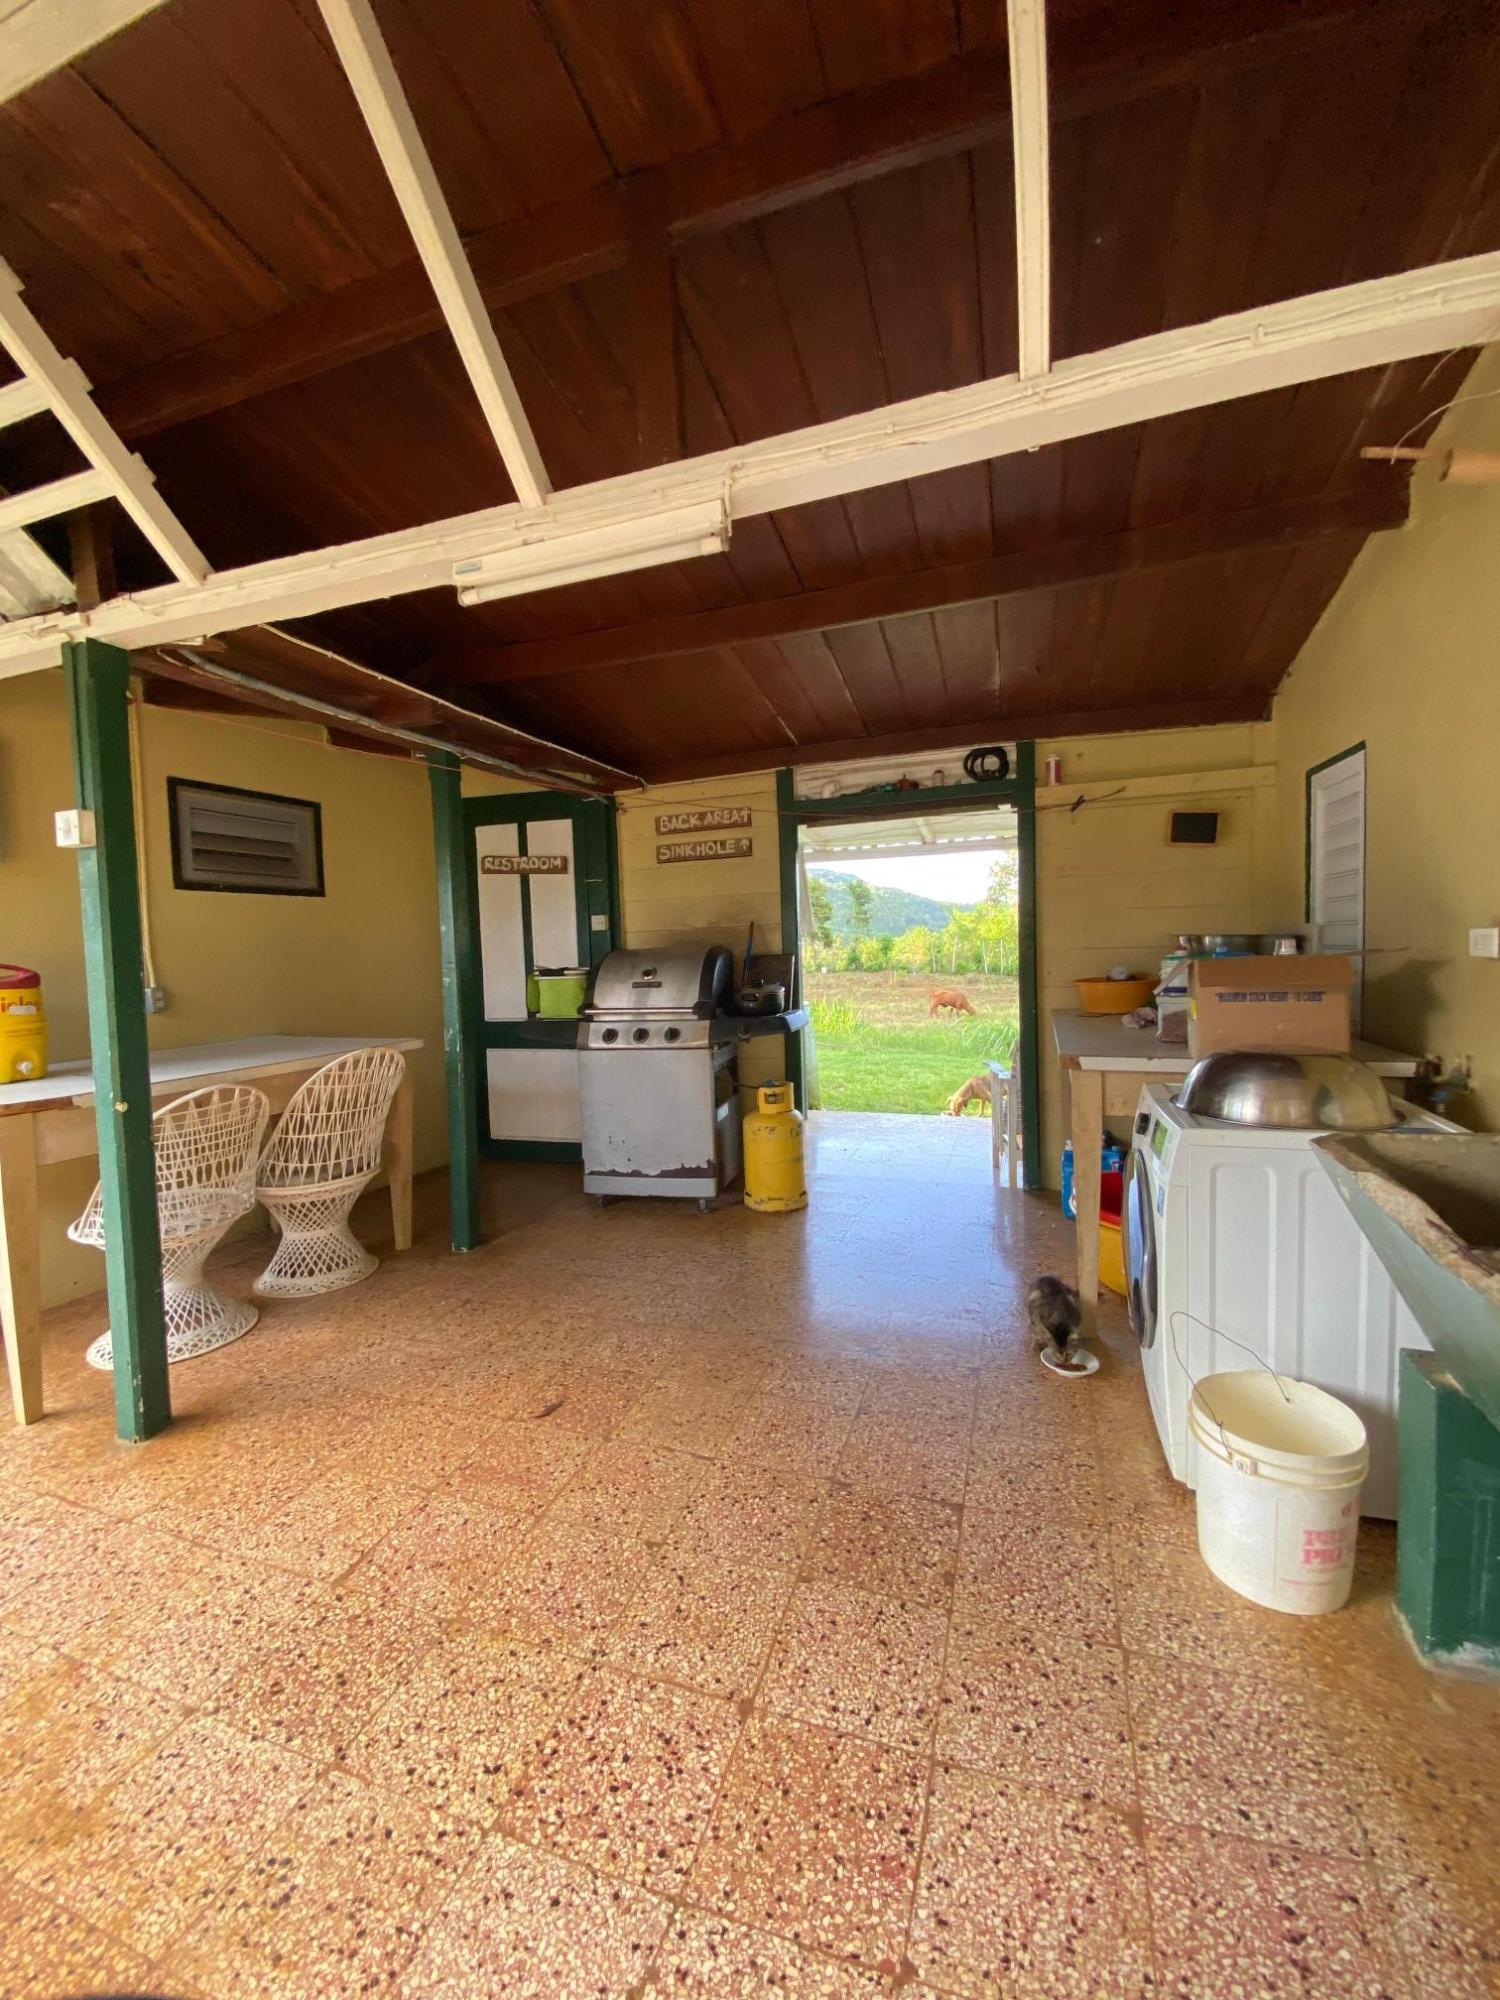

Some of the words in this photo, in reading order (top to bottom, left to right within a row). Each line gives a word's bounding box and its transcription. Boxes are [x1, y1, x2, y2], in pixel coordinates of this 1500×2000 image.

[660, 813, 701, 832] BACK
[704, 809, 740, 826] AREA
[659, 840, 736, 860] SINKHOLE
[484, 856, 561, 872] RESTROOM
